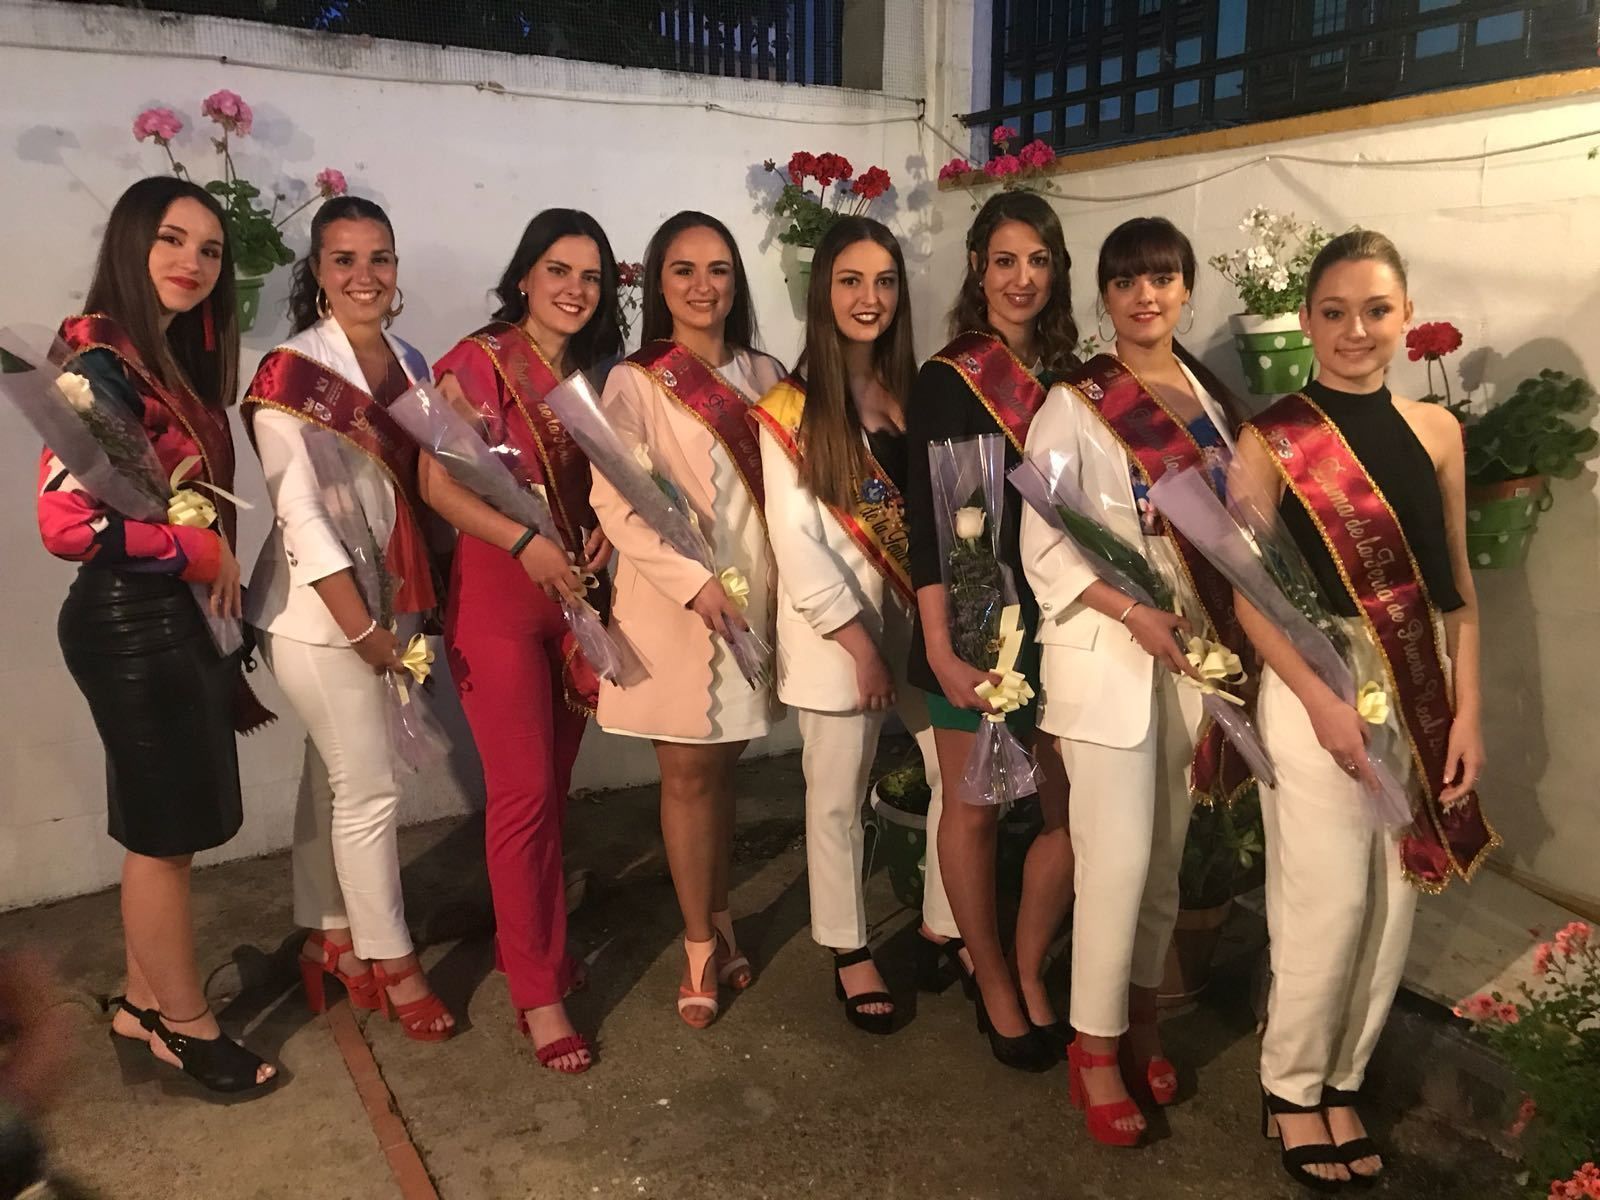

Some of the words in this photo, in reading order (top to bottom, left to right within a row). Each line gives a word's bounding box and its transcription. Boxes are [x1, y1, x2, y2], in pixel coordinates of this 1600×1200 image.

[859, 506, 882, 522] de
[872, 519, 889, 535] la
[1345, 519, 1371, 538] de
[1356, 536, 1381, 557] la
[1363, 548, 1395, 602] Feria
[1386, 603, 1408, 622] de
